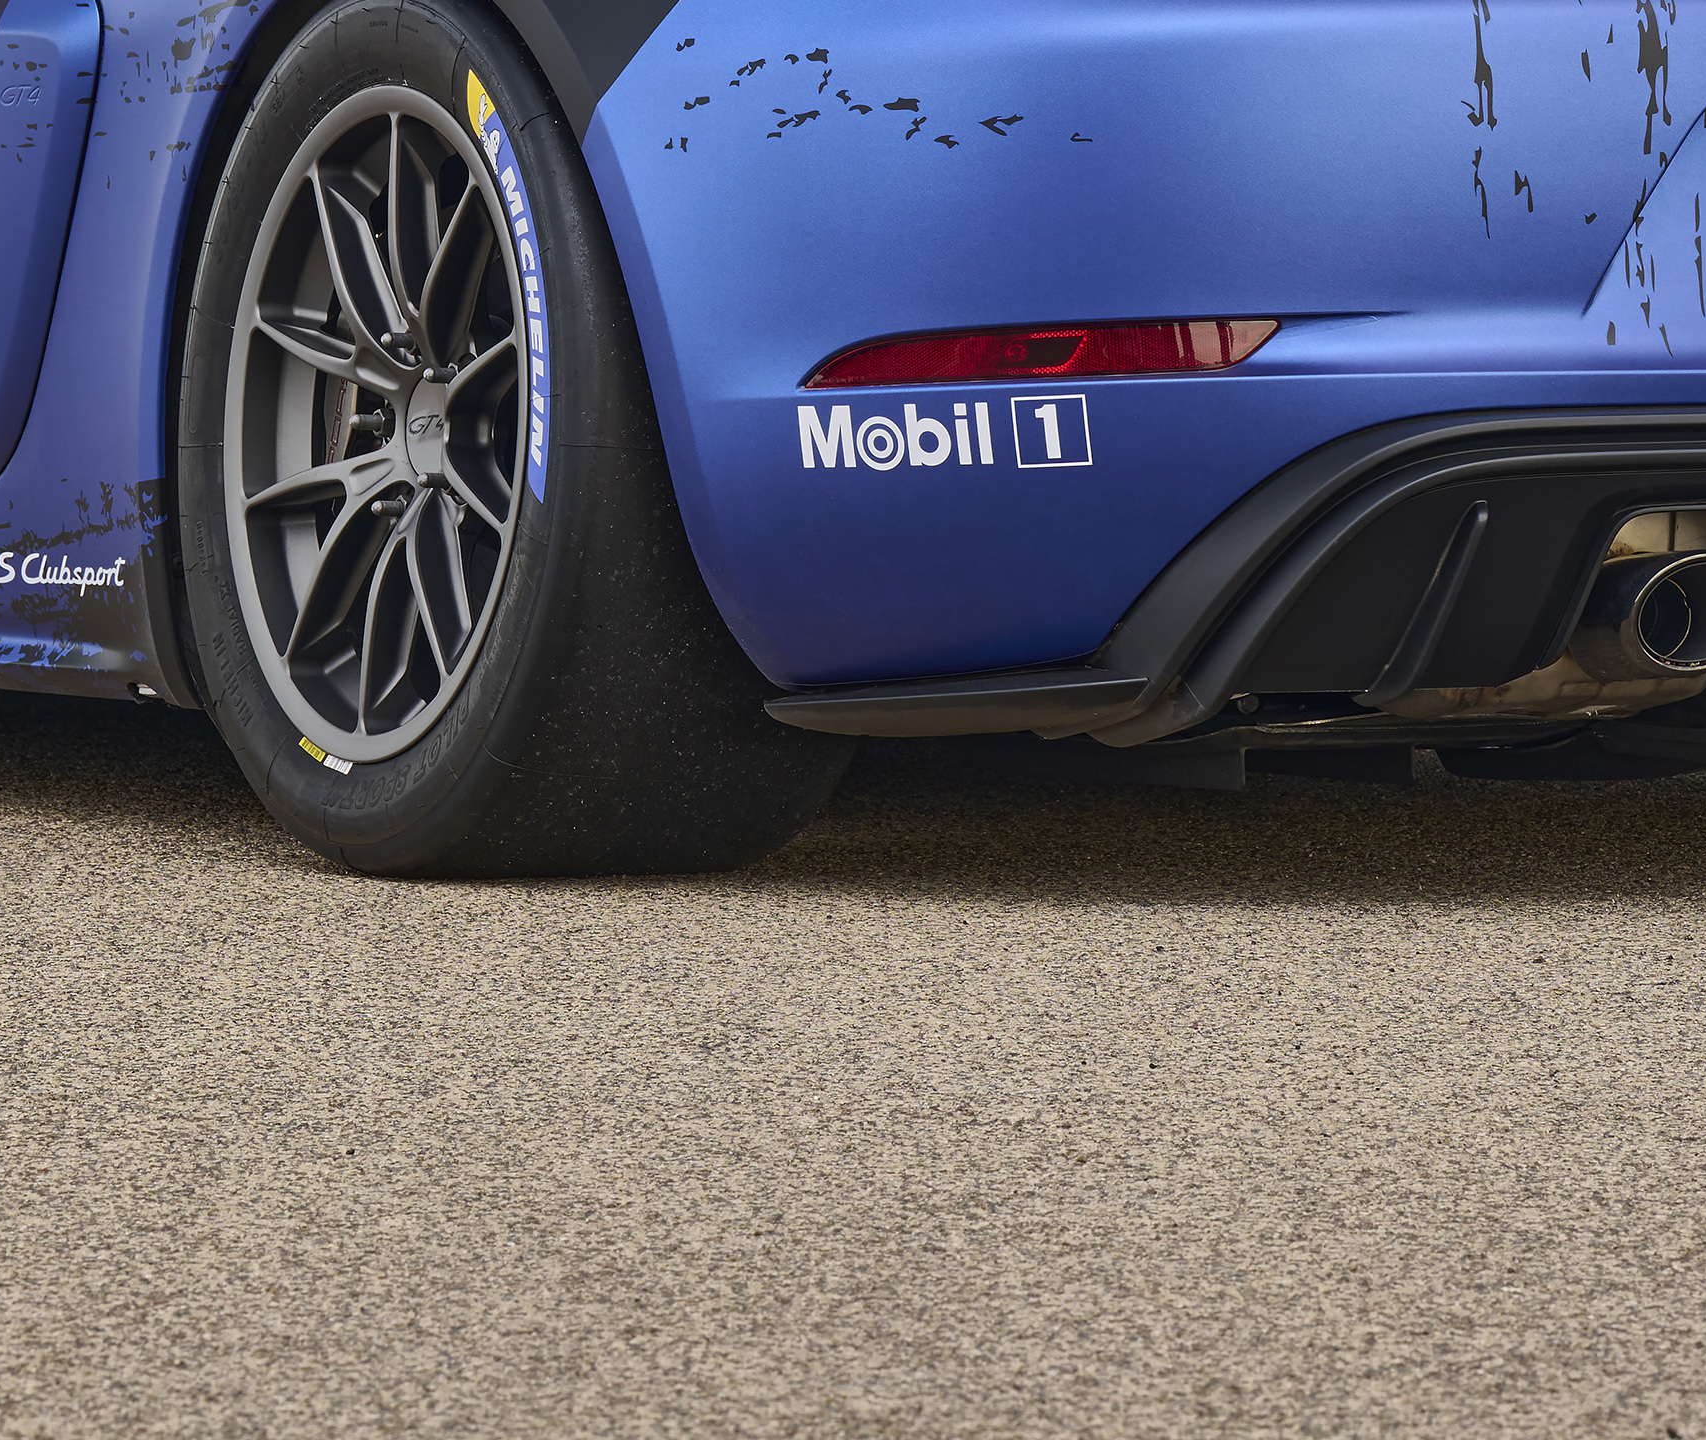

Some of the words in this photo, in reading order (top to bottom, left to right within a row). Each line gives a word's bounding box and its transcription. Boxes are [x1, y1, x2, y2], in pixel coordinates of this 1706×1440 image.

[0, 83, 42, 107] GT4
[500, 165, 545, 467] MICHELIN
[797, 401, 994, 471] Mobil
[21, 552, 126, 598] Clubsport
